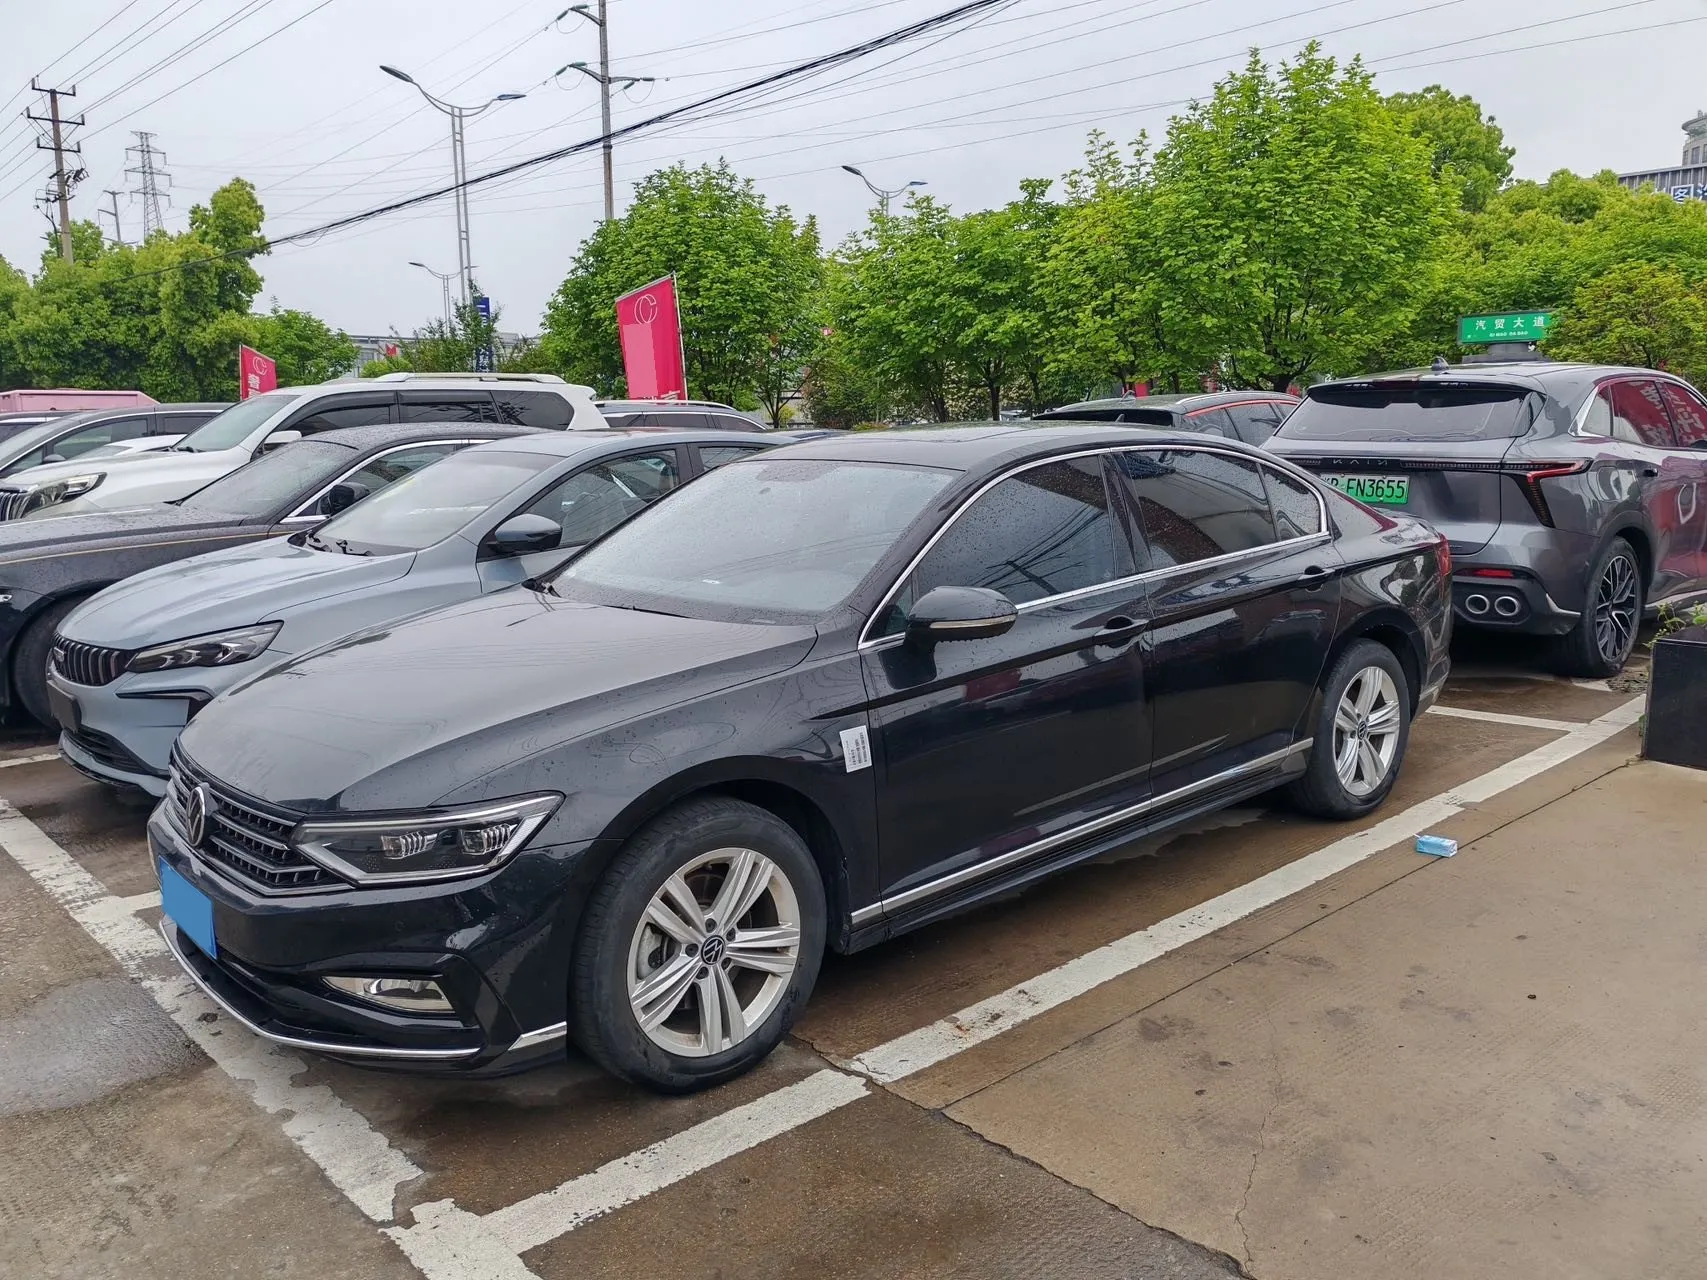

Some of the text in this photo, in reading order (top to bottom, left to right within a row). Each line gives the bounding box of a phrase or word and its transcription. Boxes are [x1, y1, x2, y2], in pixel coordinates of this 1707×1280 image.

[1475, 316, 1545, 331] 汽贸大道
[1346, 478, 1406, 499] FN3655
